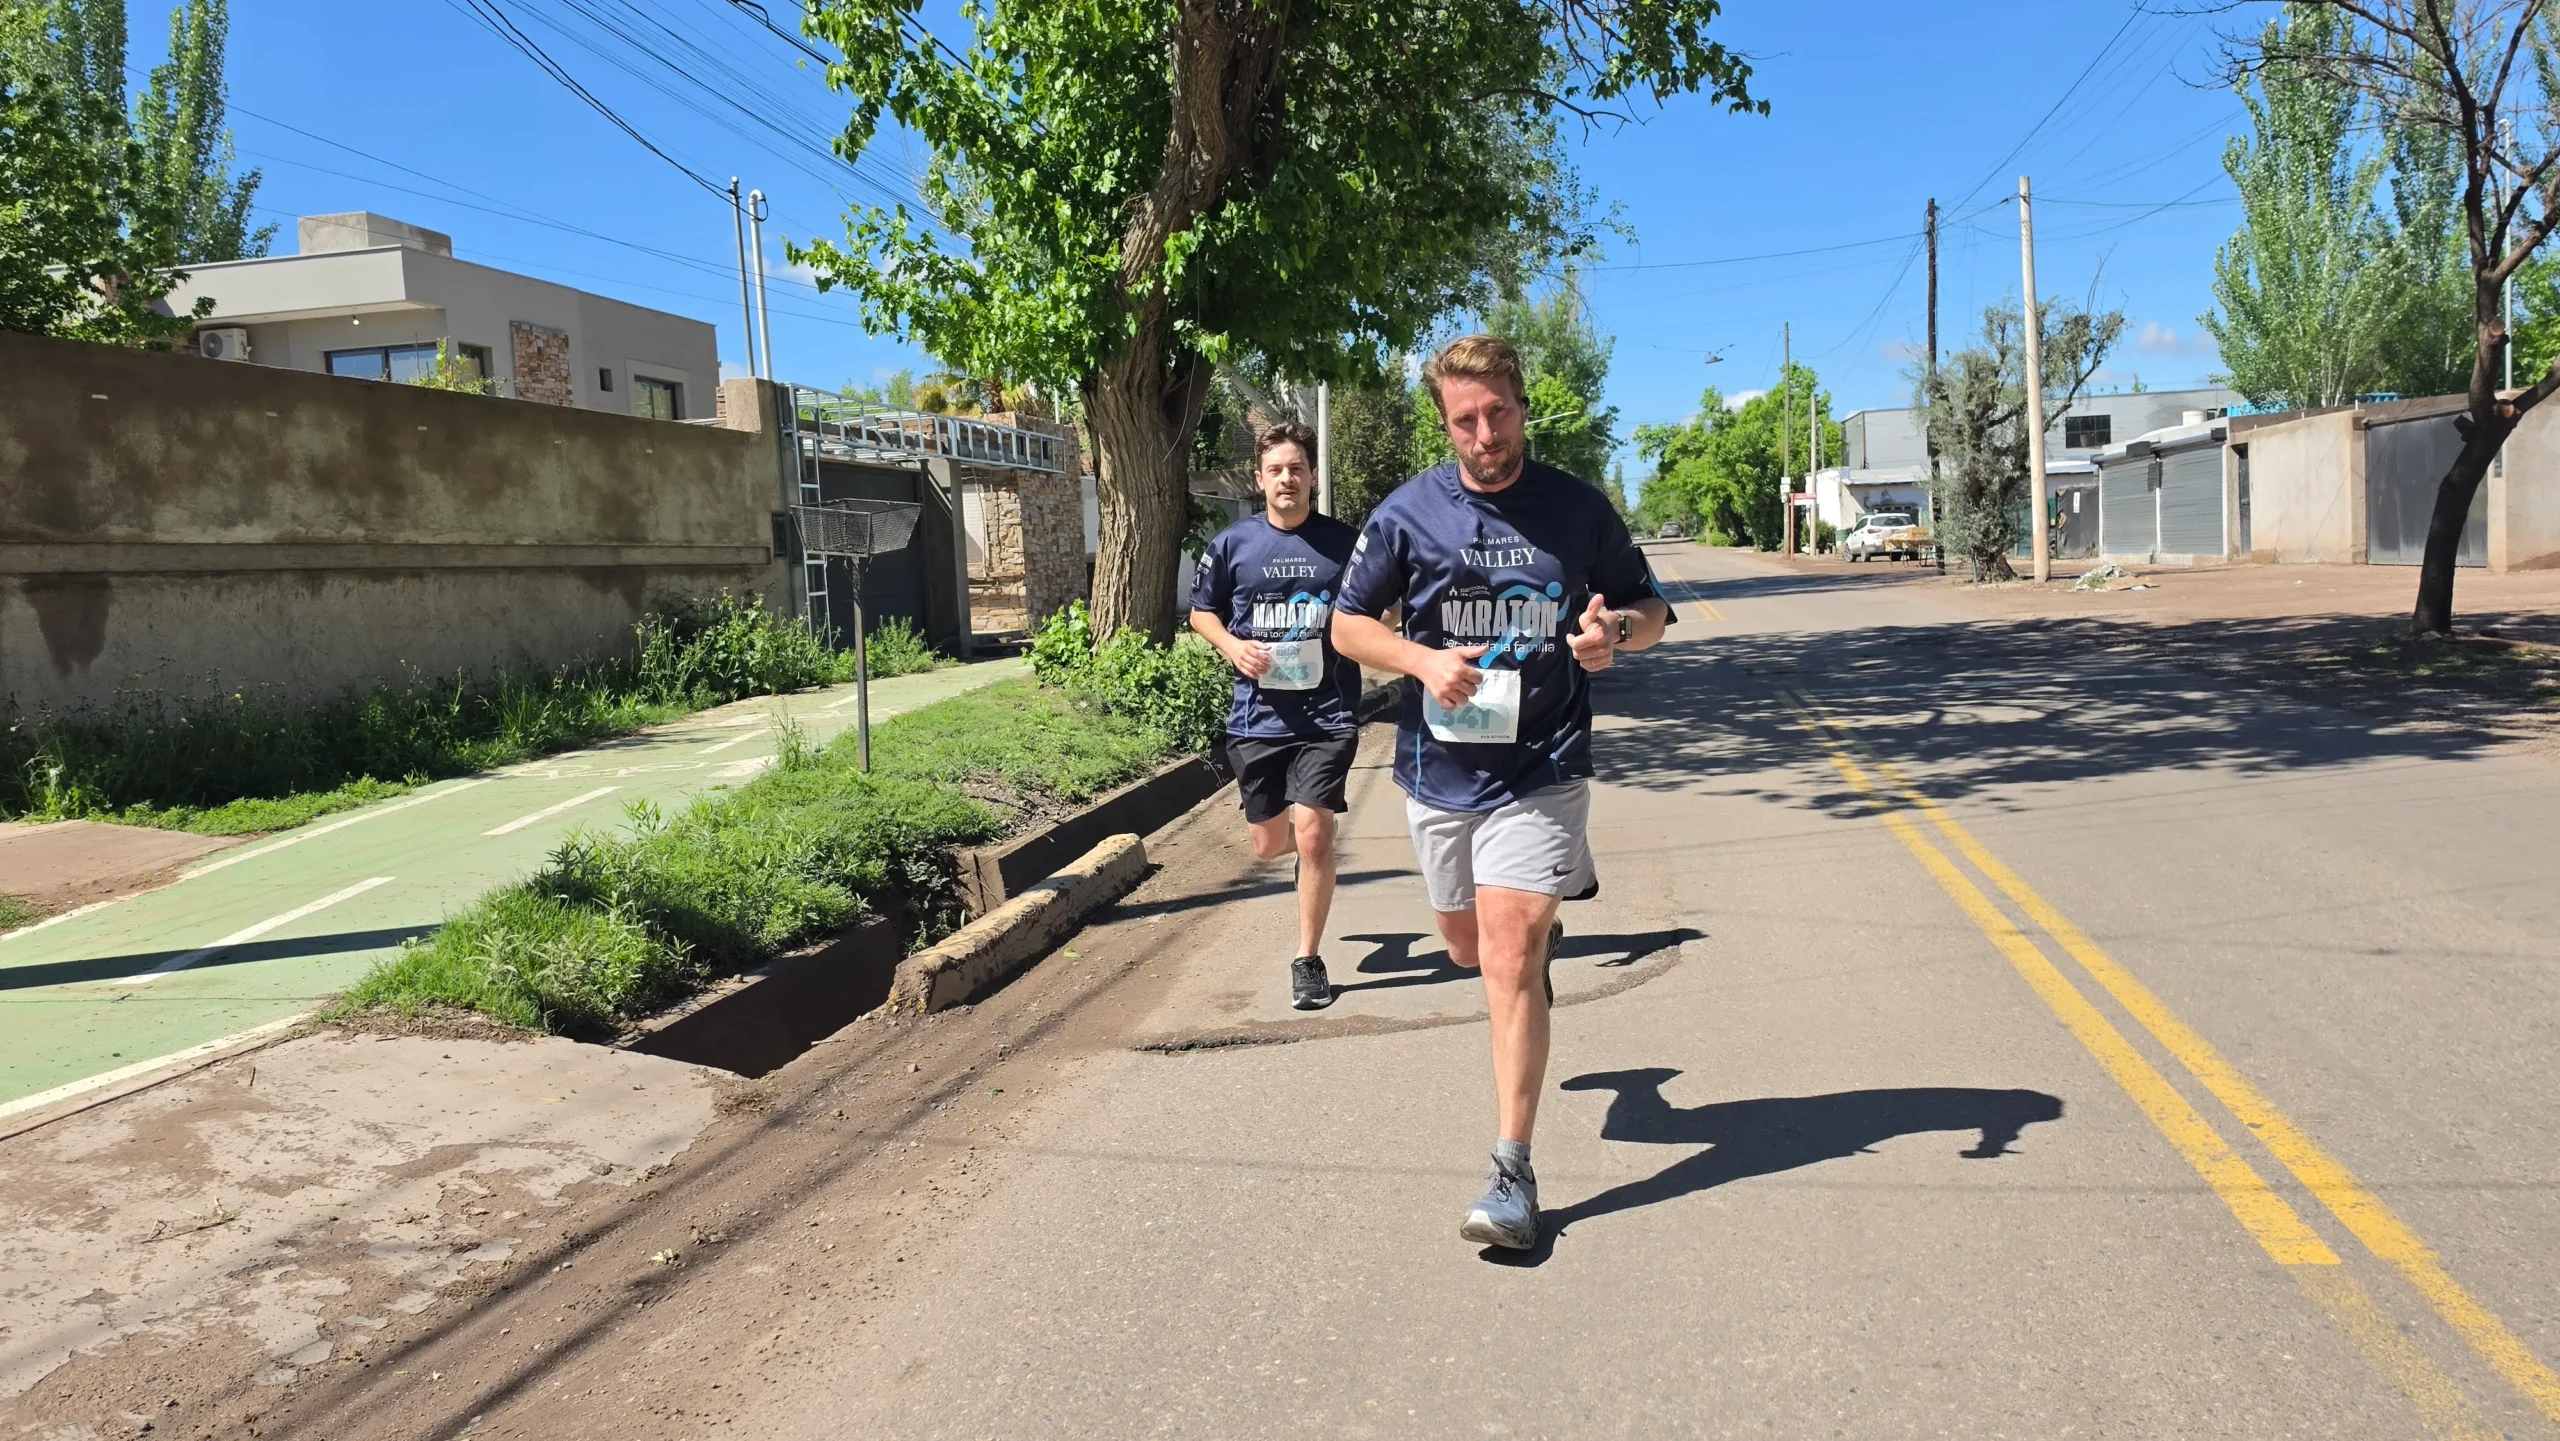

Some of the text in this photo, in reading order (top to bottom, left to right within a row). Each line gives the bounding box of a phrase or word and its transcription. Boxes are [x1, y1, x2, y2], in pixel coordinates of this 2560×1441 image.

[1472, 535, 1520, 546] PALMARES
[1459, 547, 1537, 568] VALLEY
[1262, 565, 1317, 579] VALLEY
[1253, 597, 1328, 629] MARATÓN
[1441, 593, 1559, 638] MARATÓN
[1252, 630, 1268, 638] para
[1500, 640, 1511, 652] la
[1513, 640, 1555, 653] familia
